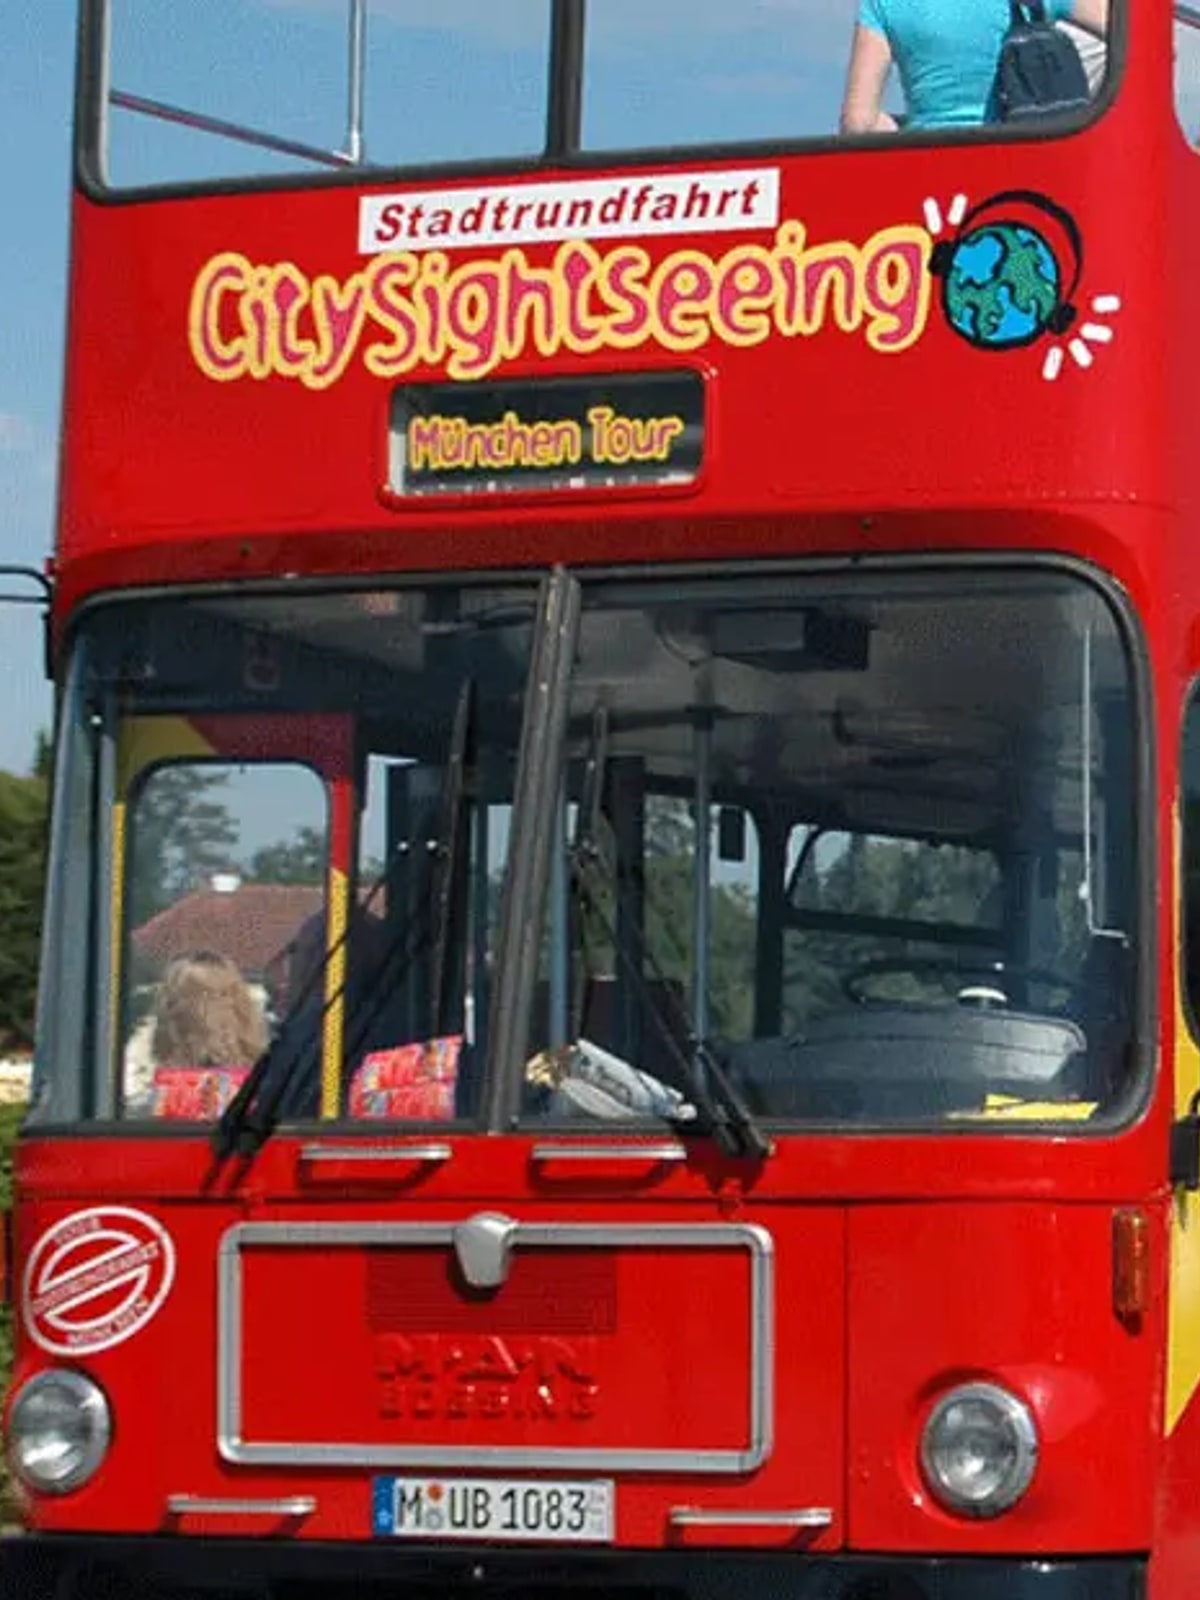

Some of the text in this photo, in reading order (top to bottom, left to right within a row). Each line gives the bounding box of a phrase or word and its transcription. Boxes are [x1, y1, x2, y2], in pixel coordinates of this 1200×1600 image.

[374, 178, 762, 244] Stadtrundfahrt
[188, 221, 933, 389] CitySightseeing
[409, 404, 685, 471] München Tour
[398, 1487, 423, 1528] M
[450, 1488, 492, 1529] UB
[501, 1489, 586, 1532] 1083
